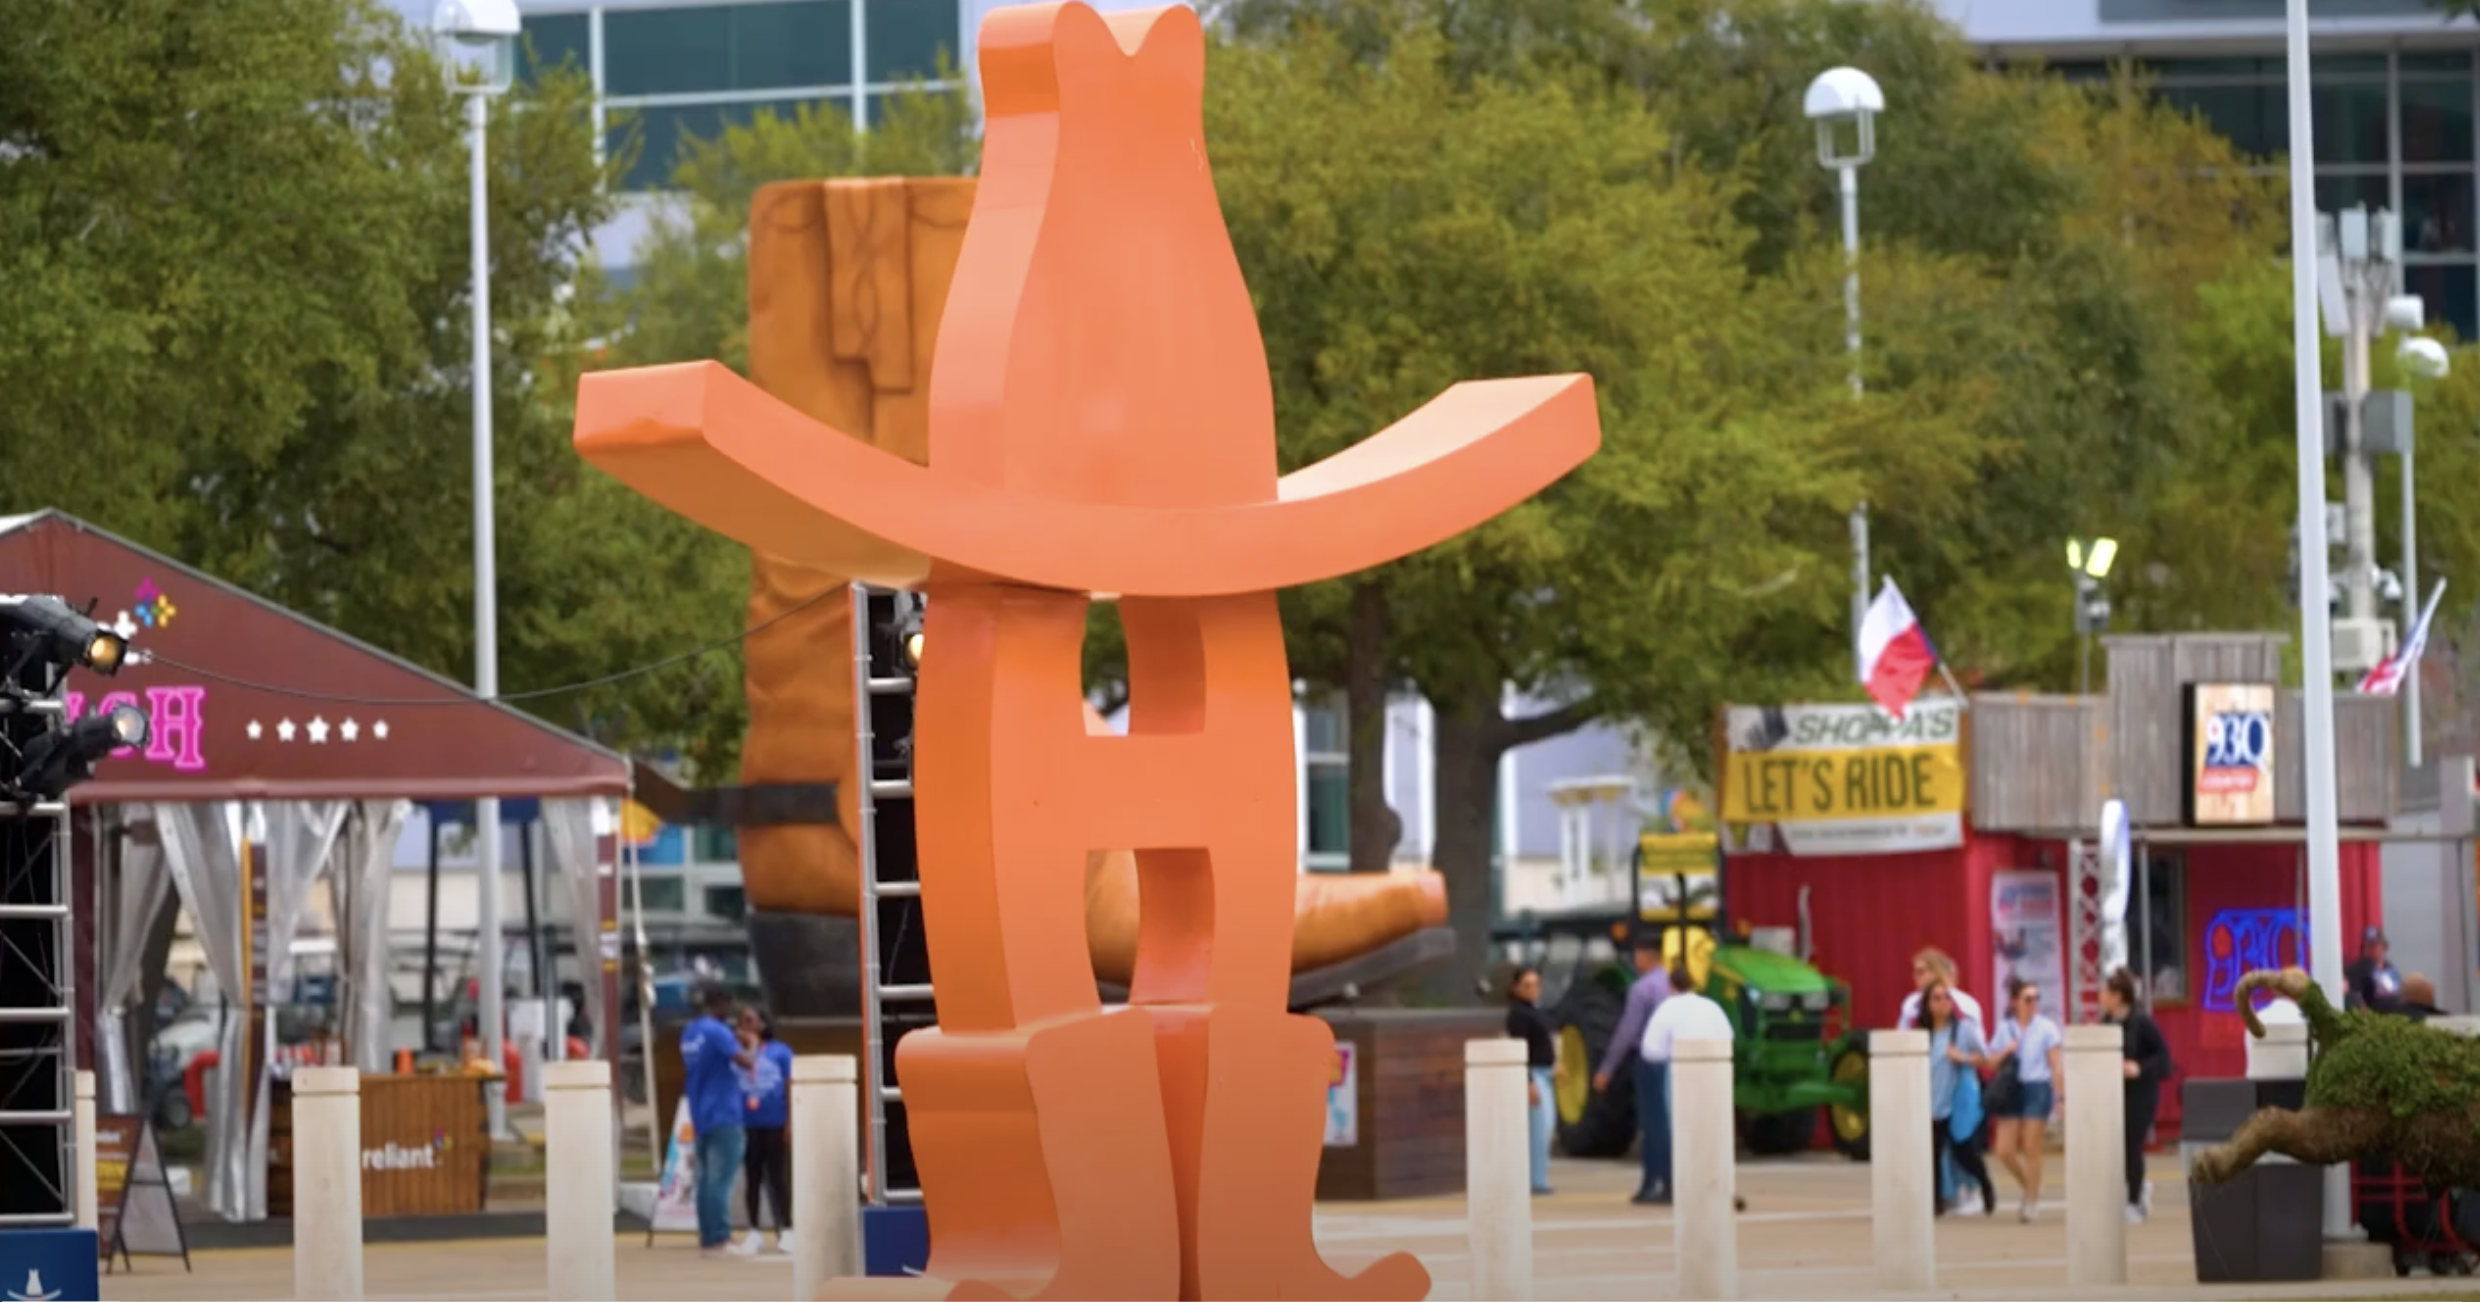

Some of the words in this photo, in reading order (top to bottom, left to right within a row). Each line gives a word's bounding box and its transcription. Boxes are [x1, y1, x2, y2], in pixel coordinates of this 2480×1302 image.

[2207, 712, 2271, 772] 93Q
[1744, 757, 1833, 814] LET'S
[1845, 752, 1937, 809] RIDE
[361, 1139, 434, 1170] reliant
